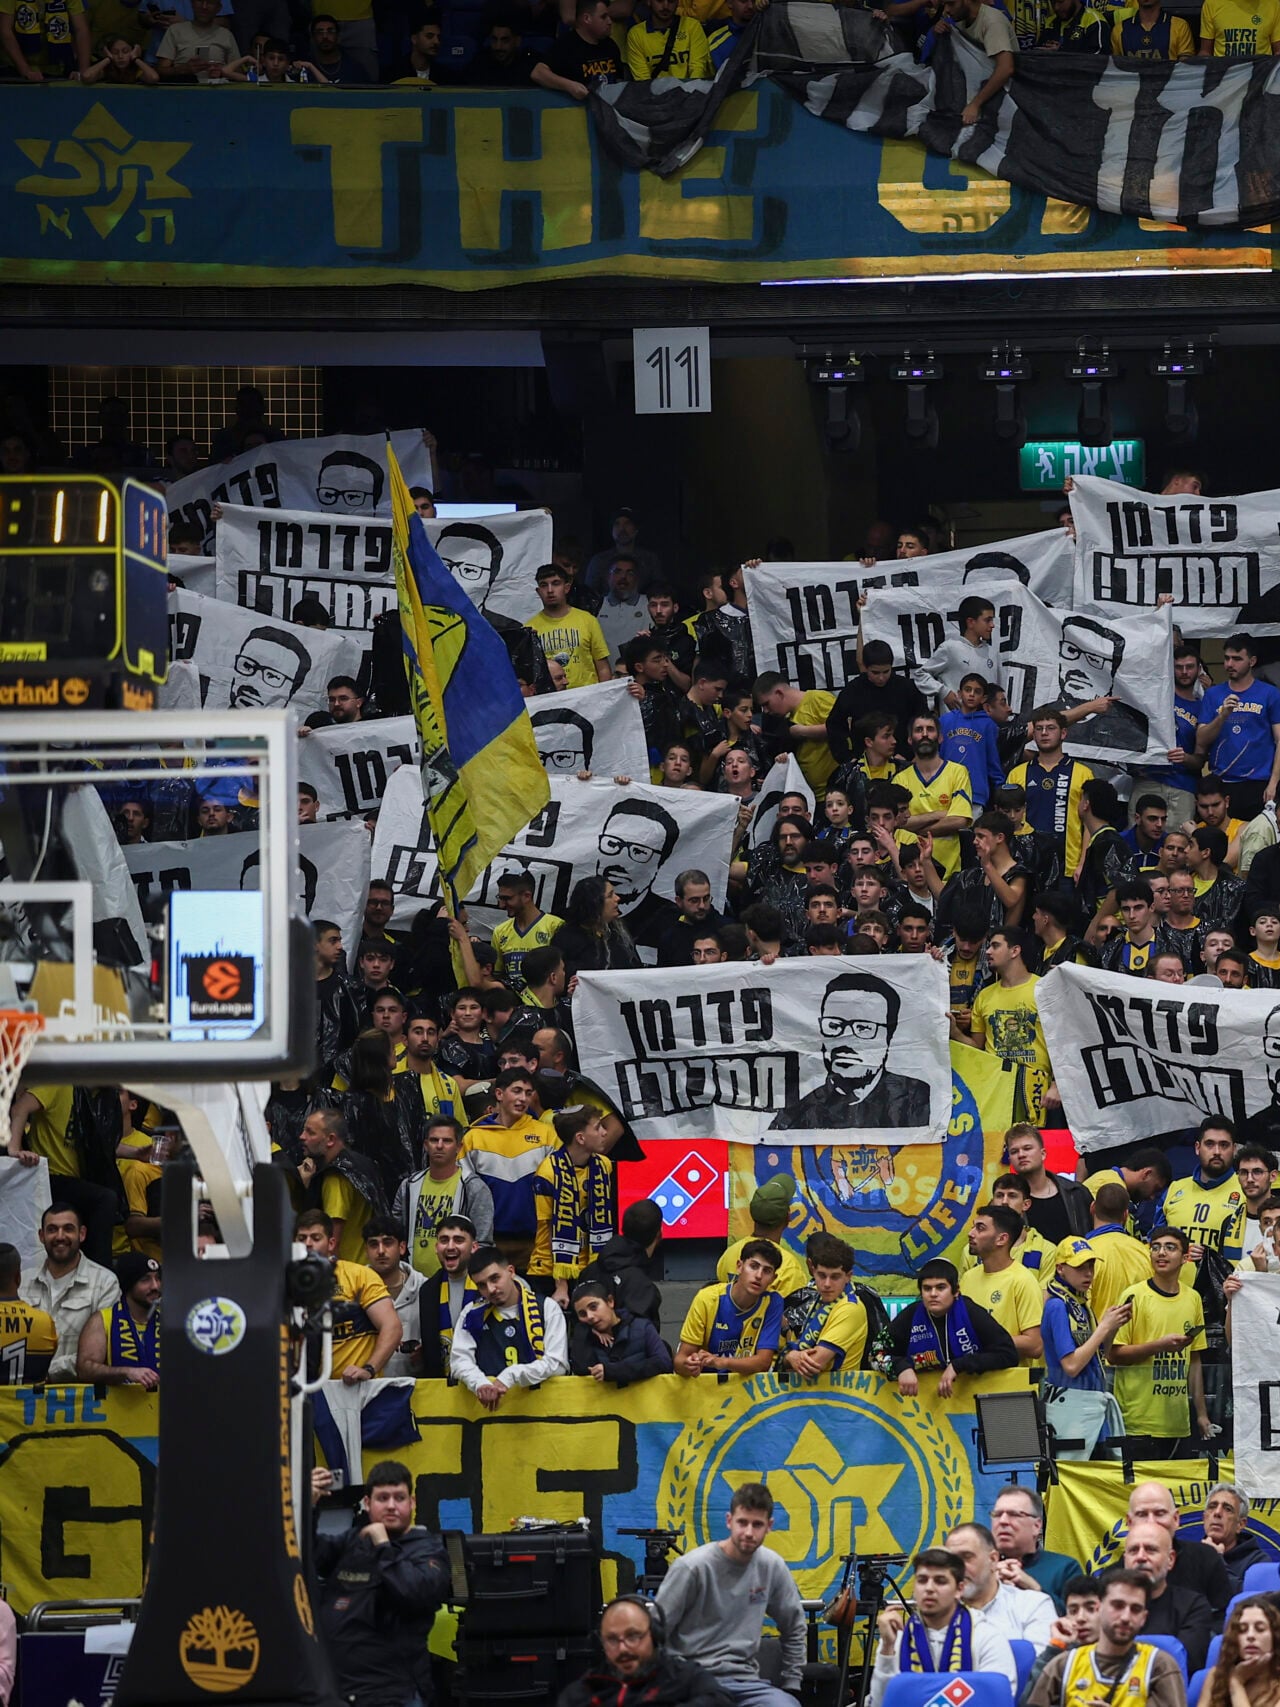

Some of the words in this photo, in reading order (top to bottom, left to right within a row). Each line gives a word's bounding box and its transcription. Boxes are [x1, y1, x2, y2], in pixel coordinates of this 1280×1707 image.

[1224, 28, 1257, 43] WE'RE
[583, 59, 617, 77] MADE
[290, 90, 758, 250] THE
[646, 346, 700, 408] 11
[1063, 443, 1134, 483] יציאה
[257, 521, 393, 573] פדרמן
[1106, 501, 1238, 554] פדרמן
[1101, 557, 1248, 604] תמכור!
[0, 678, 59, 706] erland
[620, 988, 773, 1059] פדרמן
[1084, 991, 1219, 1056] פדרמן
[622, 1055, 786, 1118] תמכור!
[901, 1178, 971, 1260] LIFE
[1193, 1203, 1210, 1223] 10
[0, 1317, 34, 1334] MY
[118, 1319, 139, 1361] AVIV
[505, 1346, 518, 1366] 9
[16, 1387, 107, 1425] THE
